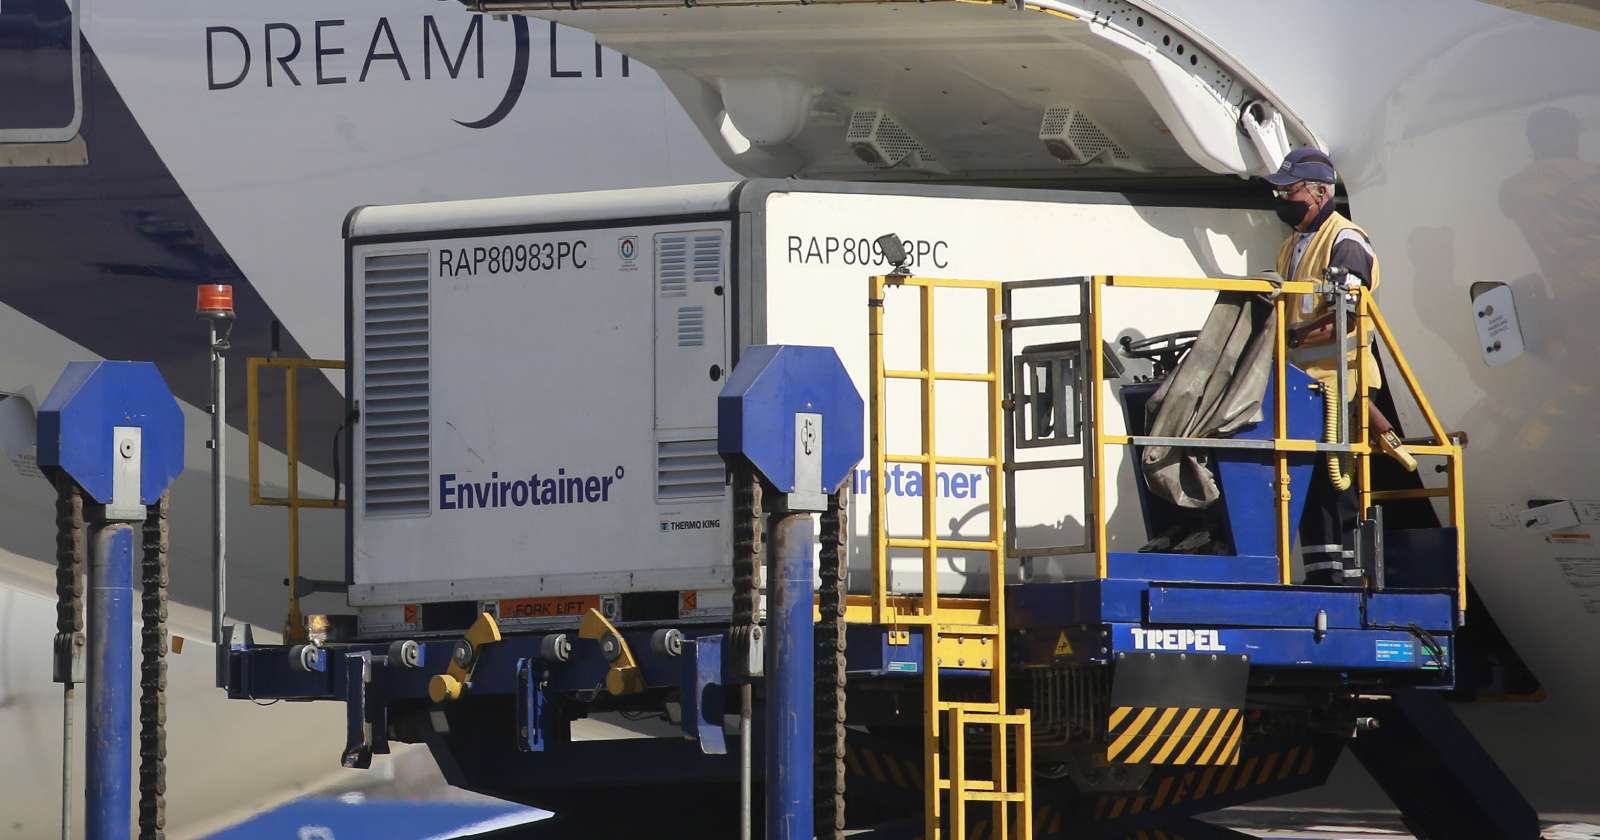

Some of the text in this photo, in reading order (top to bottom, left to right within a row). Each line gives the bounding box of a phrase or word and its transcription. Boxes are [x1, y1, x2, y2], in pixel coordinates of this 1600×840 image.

[438, 240, 588, 278] RAP80983PC
[787, 235, 949, 269] RAP8093PC
[670, 519, 720, 531] THERMO KING
[515, 600, 585, 618] FORK LIFT
[1131, 628, 1226, 651] TREPEL
